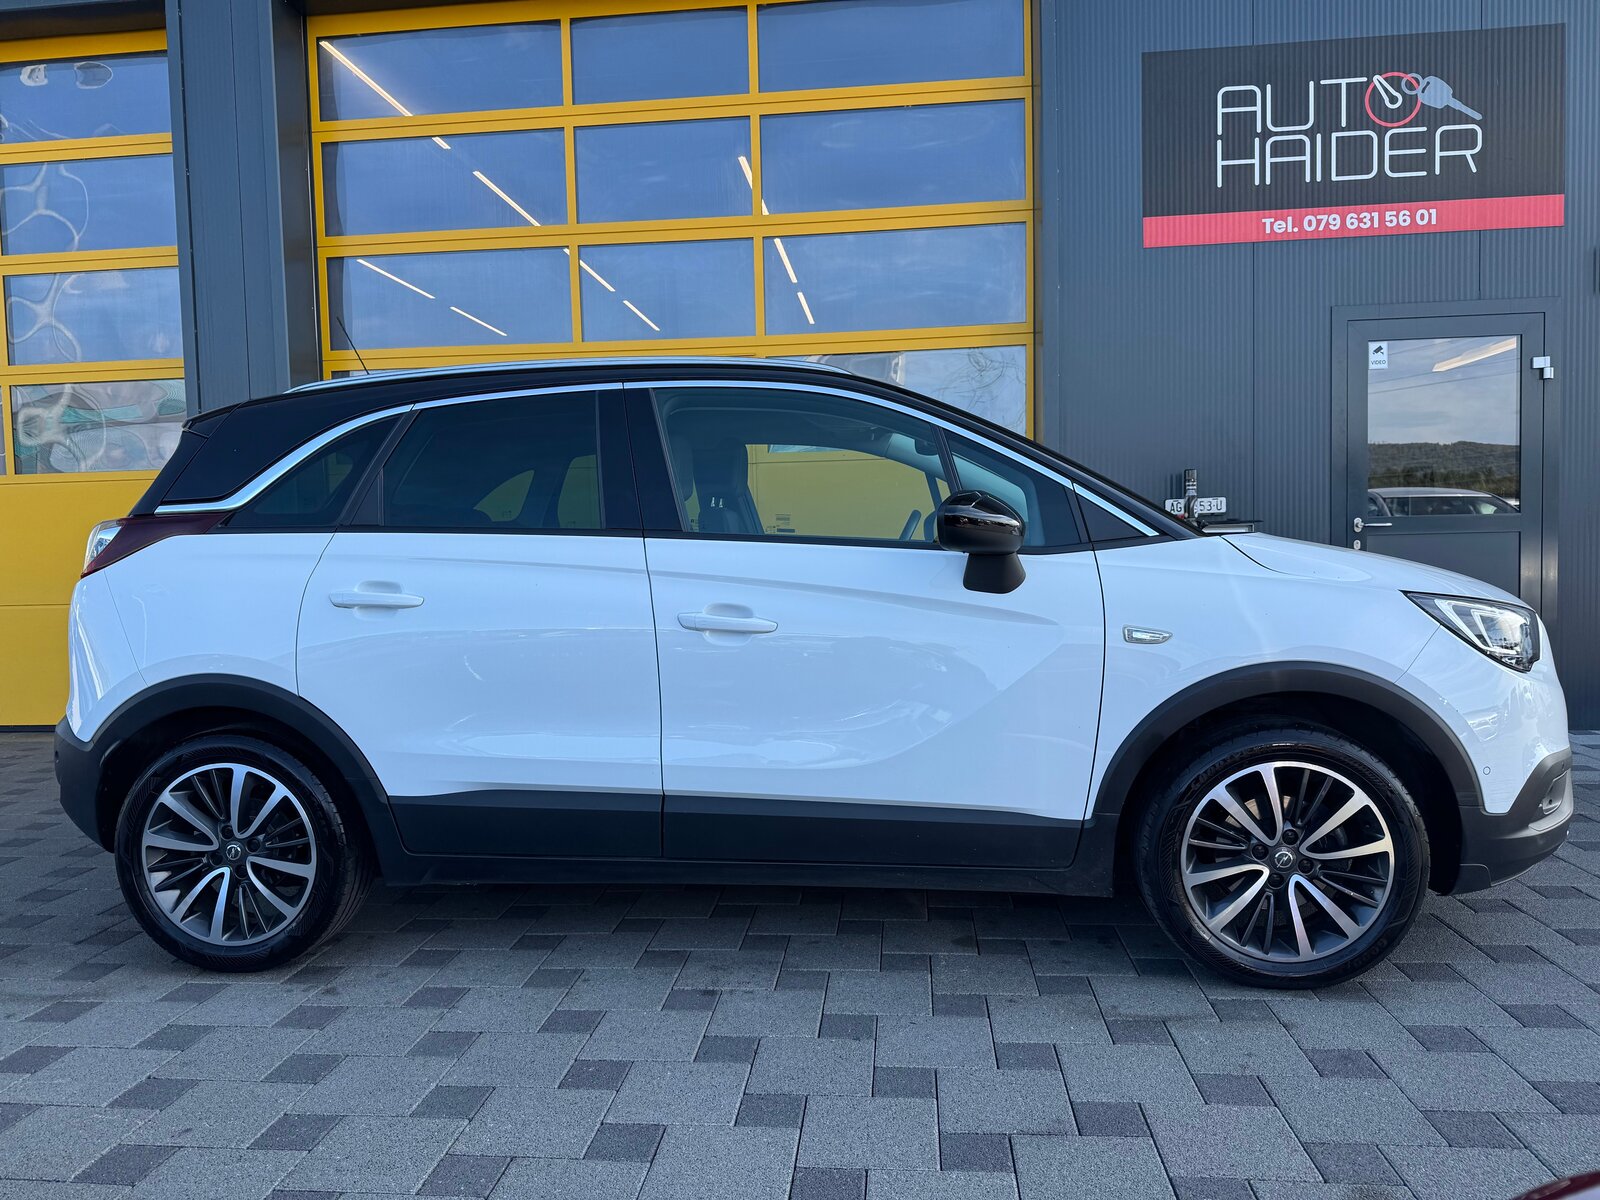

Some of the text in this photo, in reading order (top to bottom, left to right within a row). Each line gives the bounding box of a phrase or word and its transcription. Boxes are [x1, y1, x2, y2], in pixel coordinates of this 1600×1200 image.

[1217, 124, 1482, 188] HAIDER
[1262, 208, 1437, 234] Tel. 079 631 56 01
[1170, 501, 1182, 513] AG
